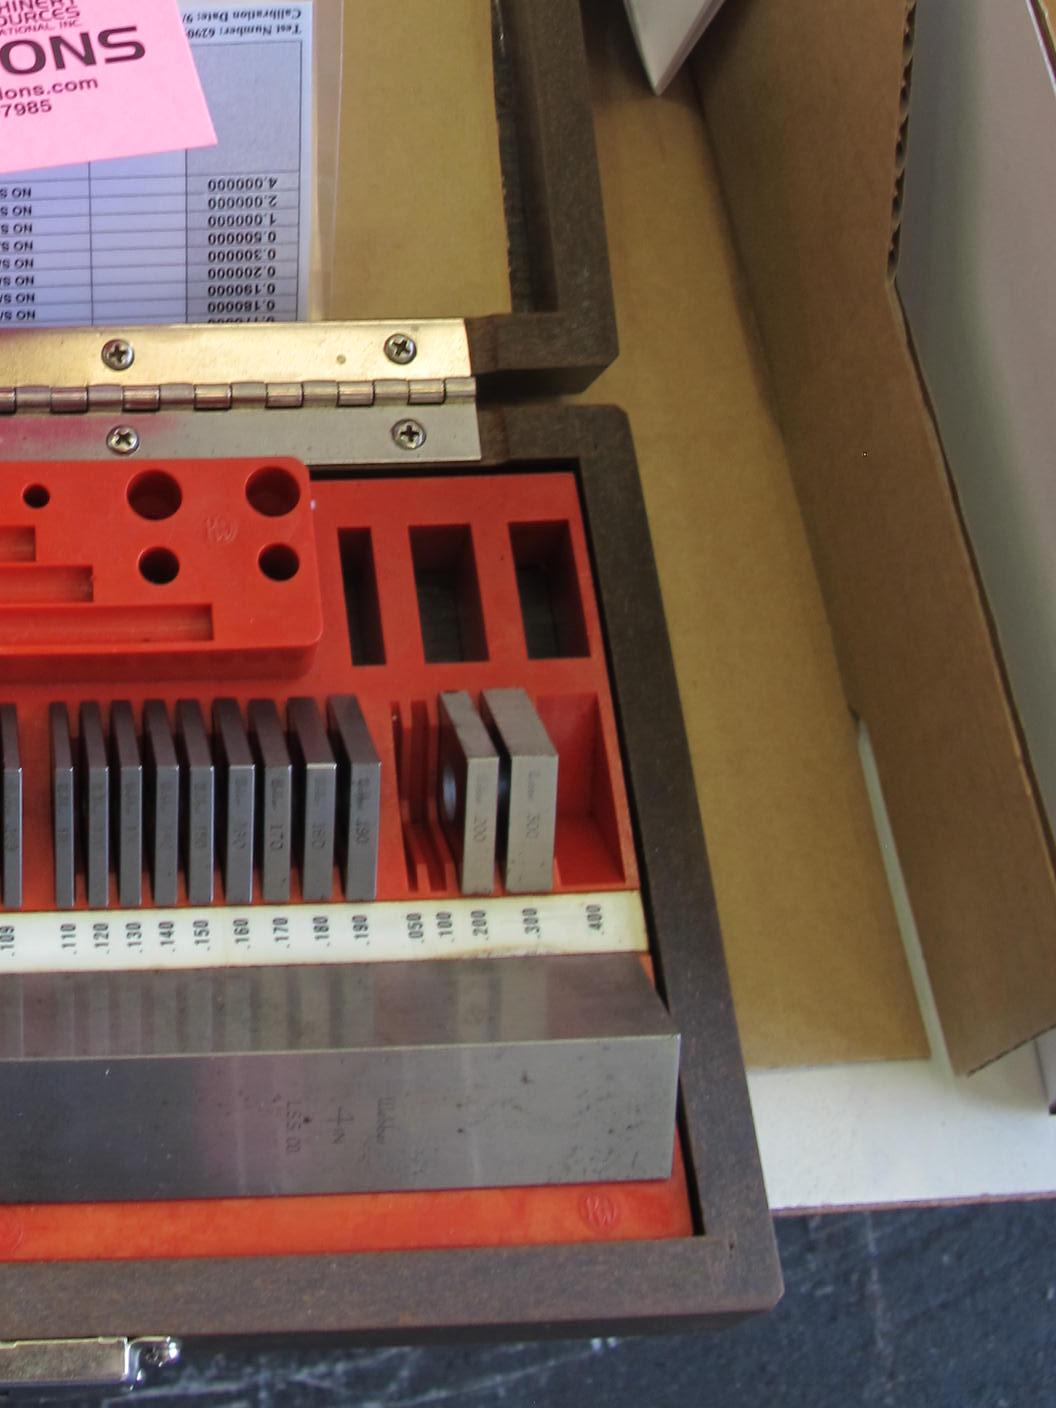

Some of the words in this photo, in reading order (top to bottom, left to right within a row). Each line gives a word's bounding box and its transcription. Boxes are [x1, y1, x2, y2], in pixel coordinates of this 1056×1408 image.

[197, 12, 230, 23] Date:
[232, 9, 302, 20] Calibration
[219, 26, 273, 38] Number:
[11, 187, 32, 198] NO
[12, 206, 32, 217] NO
[13, 223, 33, 234] NO
[13, 241, 34, 252] NO
[14, 258, 34, 269] NO
[15, 276, 35, 287] NO
[15, 293, 35, 304] NO
[16, 310, 36, 321] NO
